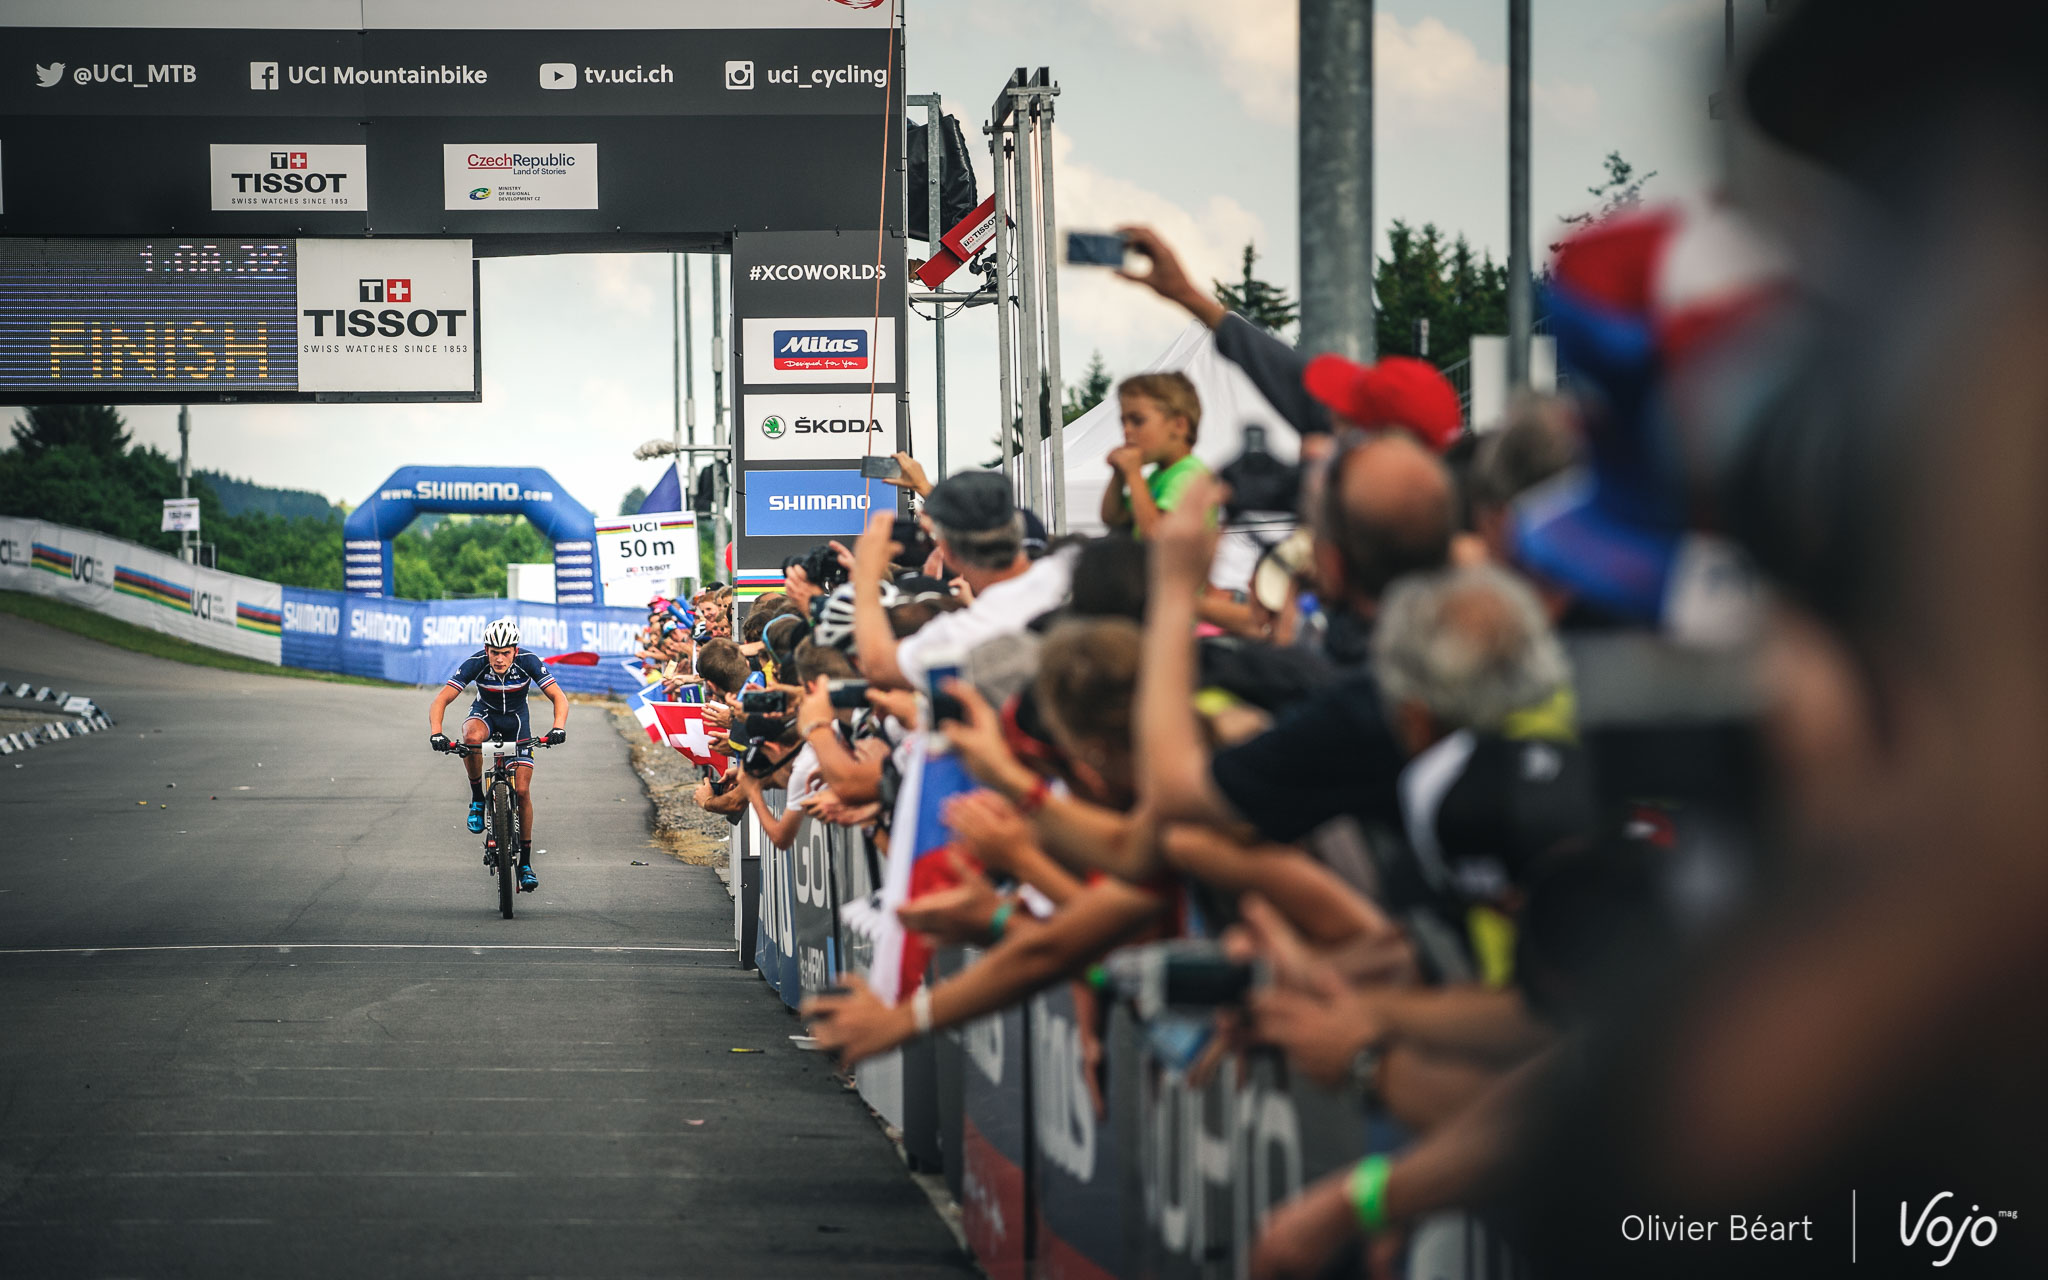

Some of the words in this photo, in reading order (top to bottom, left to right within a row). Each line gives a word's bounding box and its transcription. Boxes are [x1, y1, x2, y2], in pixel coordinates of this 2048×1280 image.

[73, 64, 197, 88] @UCI_MTB
[288, 65, 326, 84] UCI
[334, 65, 488, 84] Mountainbike
[584, 65, 674, 84] tv.uci.ch
[767, 65, 888, 88] uci_cycling
[231, 173, 347, 193] TISSOT
[750, 264, 887, 280] #XCOWORLDS
[303, 309, 467, 337] TISSOT
[51, 321, 268, 378] FINISH
[780, 336, 859, 353] Mitas
[784, 360, 822, 369] Designed
[824, 360, 840, 368] for
[841, 360, 859, 369] You
[794, 417, 884, 433] ŠKODA
[768, 494, 871, 511] SHIMANO
[632, 522, 658, 532] UCI
[620, 539, 647, 558] 50
[653, 540, 675, 556] m
[191, 588, 212, 620] UCI
[283, 601, 340, 635] SHIMANO
[350, 609, 411, 645] SHIMANO
